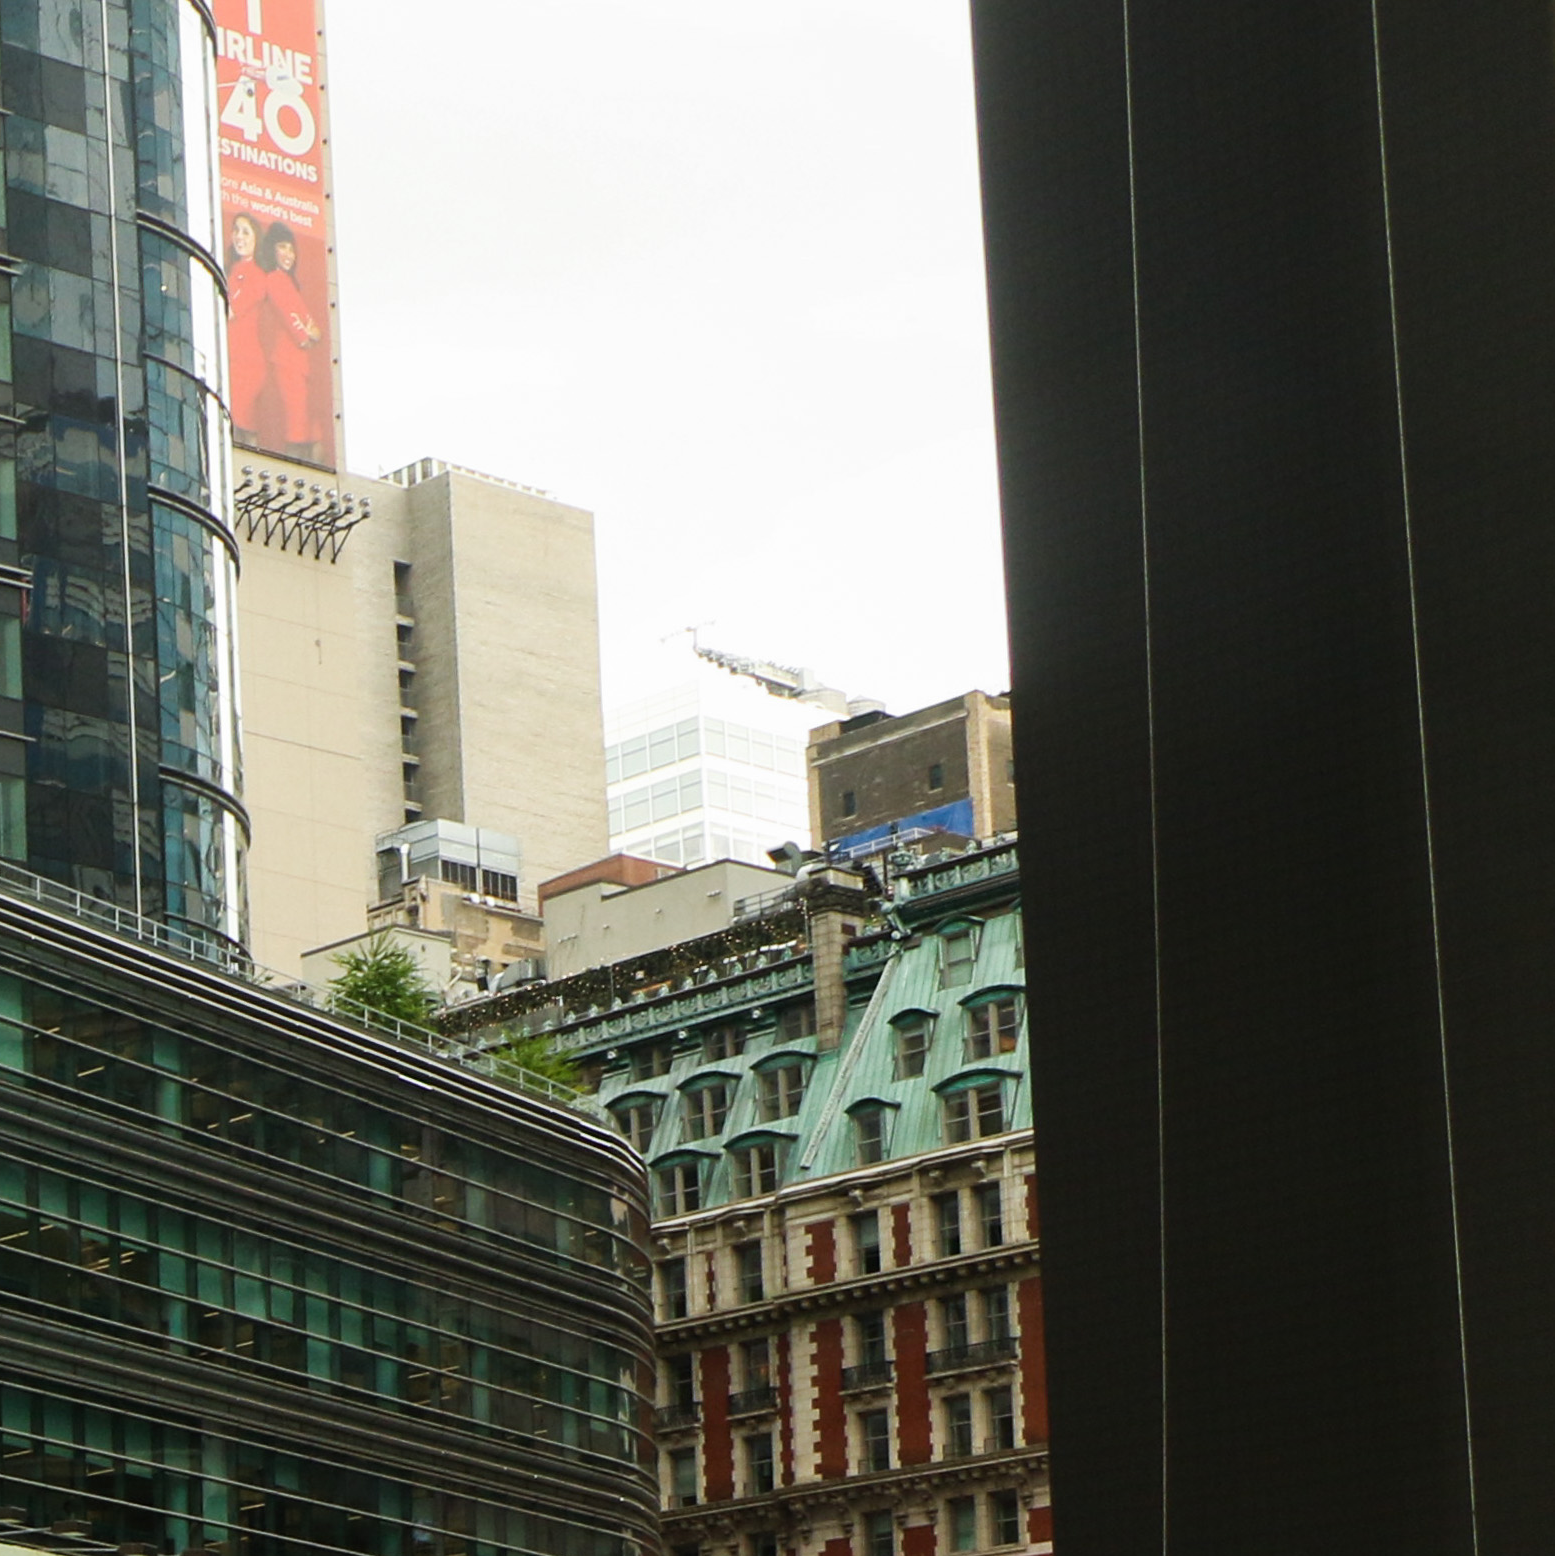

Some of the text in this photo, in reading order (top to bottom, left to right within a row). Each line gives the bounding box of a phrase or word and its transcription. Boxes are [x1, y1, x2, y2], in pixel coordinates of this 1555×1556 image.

[217, 27, 313, 85] IRLINE
[220, 76, 316, 156] 40
[218, 136, 318, 183] STINATIONS
[240, 180, 263, 198] Asia
[274, 190, 319, 215] Australia
[251, 198, 289, 220] world's
[290, 210, 313, 227] best
